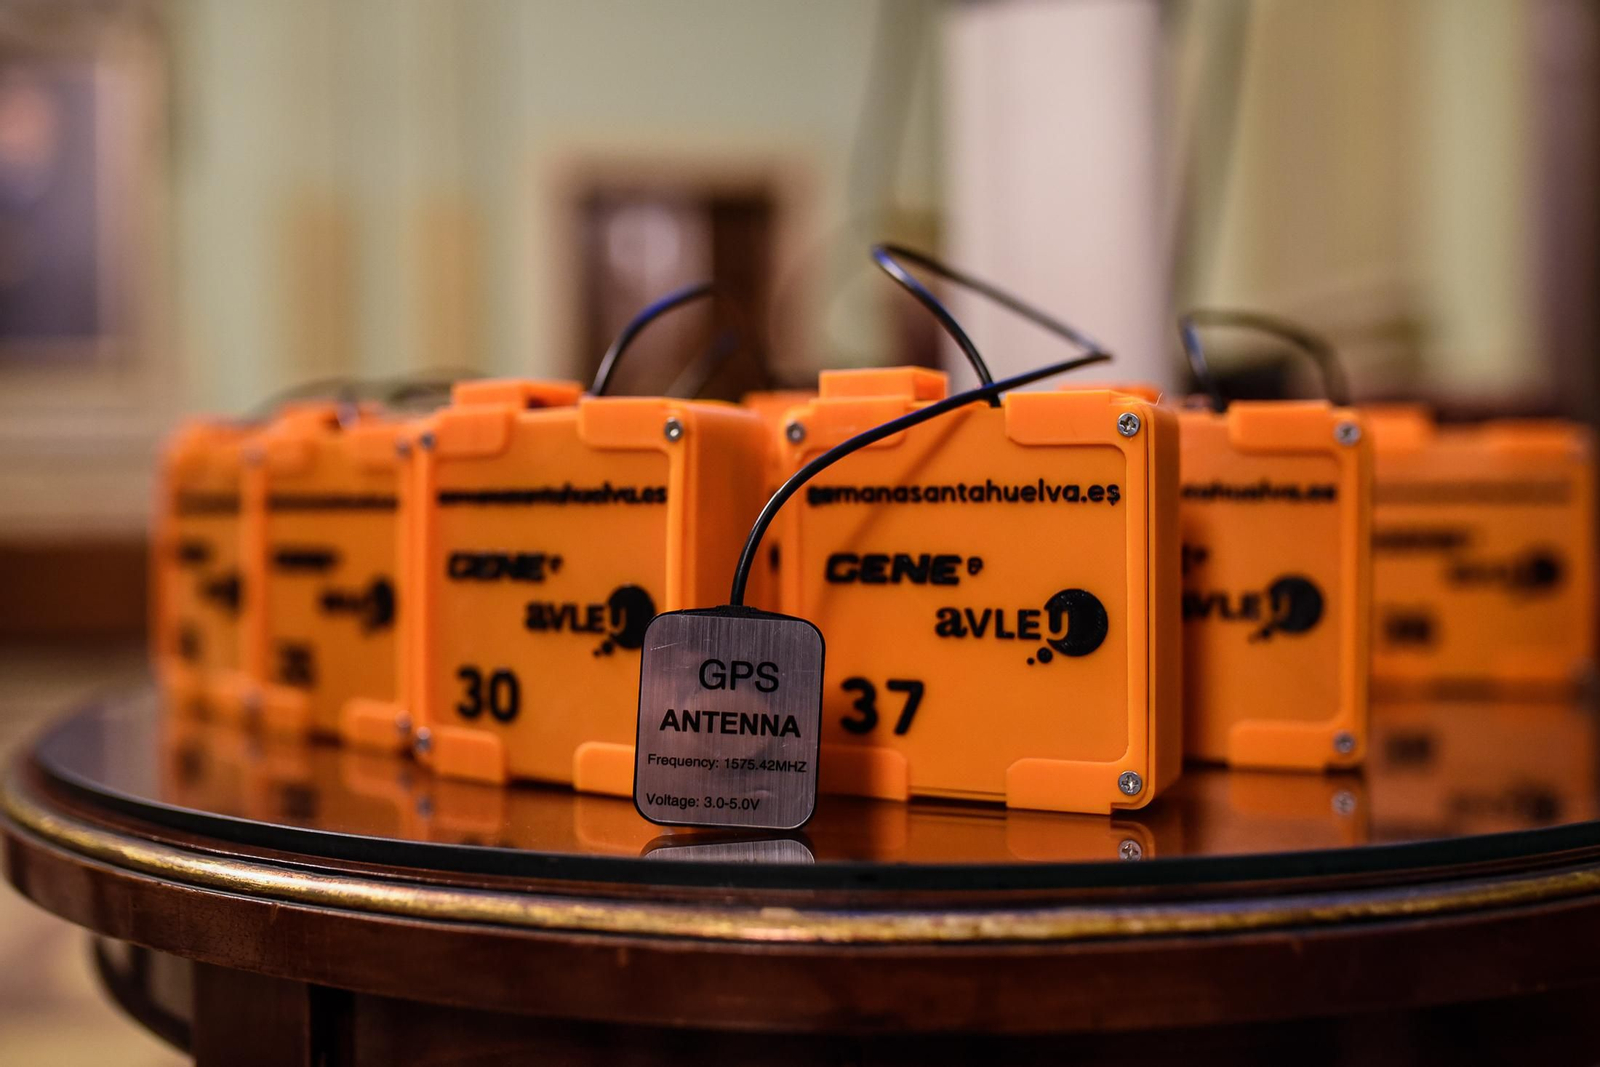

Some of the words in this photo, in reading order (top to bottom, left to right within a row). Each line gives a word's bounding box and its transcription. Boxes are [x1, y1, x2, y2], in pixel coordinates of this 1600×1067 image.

[806, 478, 1120, 507] manasantahuelva.es
[699, 658, 779, 693] GPS
[457, 665, 521, 724] 30
[840, 676, 924, 736] 37
[659, 708, 801, 738] ANTENNA
[647, 753, 719, 771] Frequency:
[724, 758, 808, 772] 1575.42MHZ
[646, 793, 700, 810] Voltage:
[704, 797, 760, 810] 3.0-5.0V
